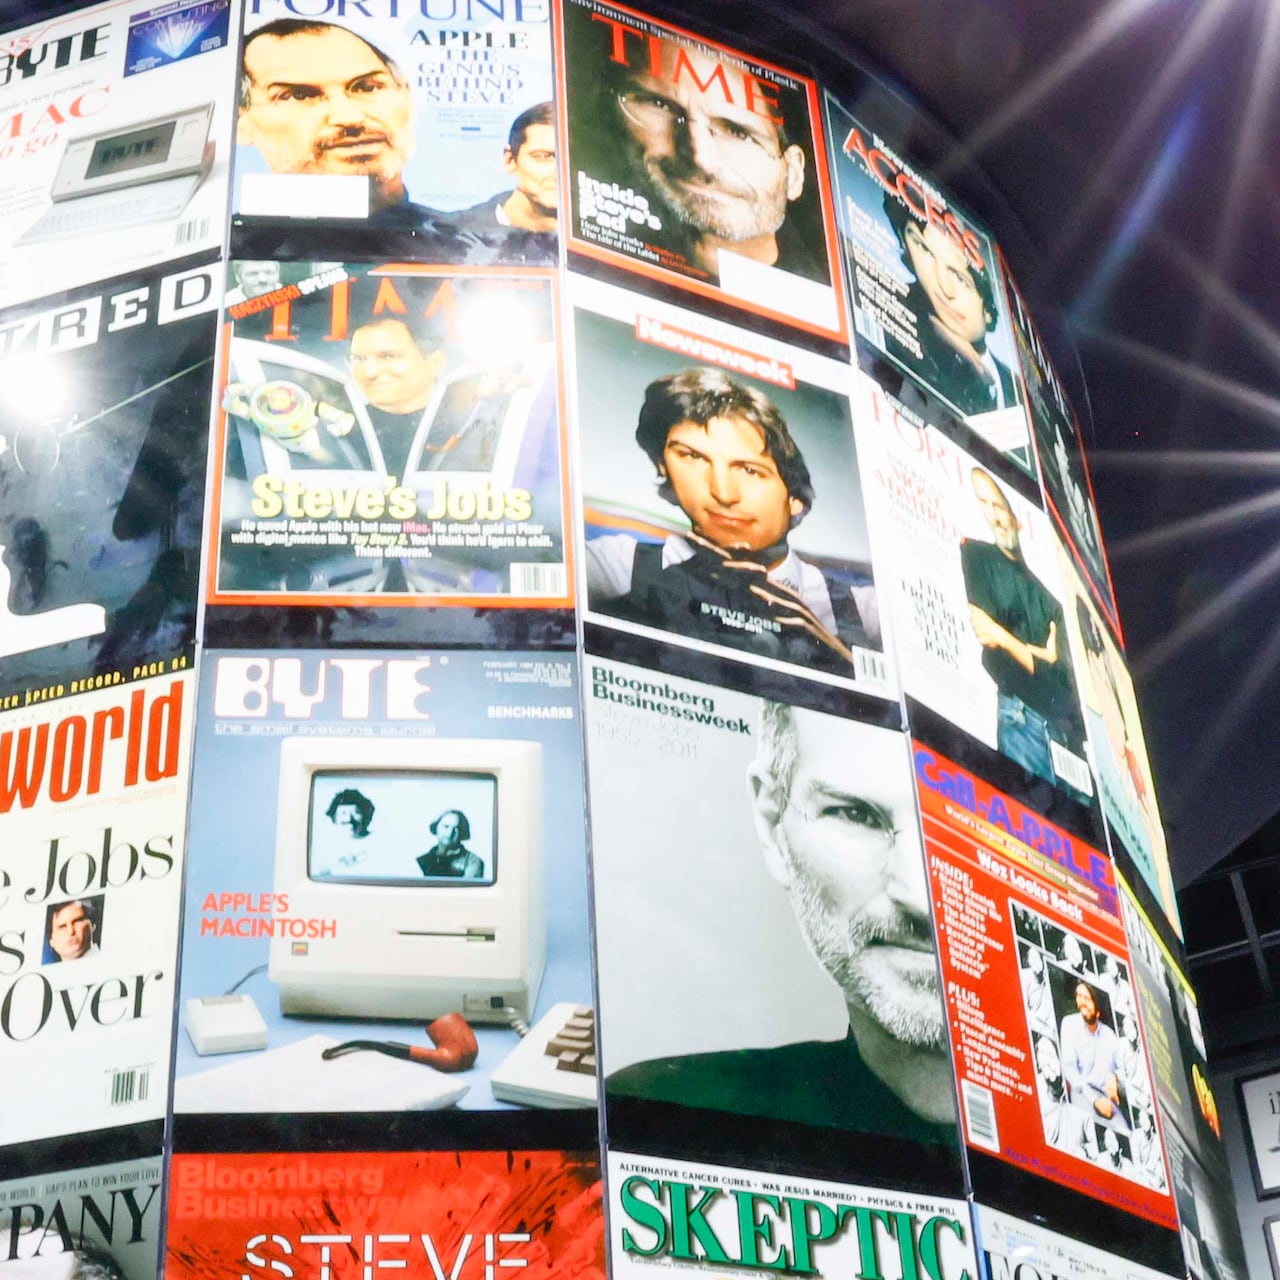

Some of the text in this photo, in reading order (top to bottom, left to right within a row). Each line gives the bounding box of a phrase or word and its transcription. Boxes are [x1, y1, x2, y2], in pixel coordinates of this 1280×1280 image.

[410, 29, 530, 49] APPLE
[417, 77, 524, 89] BEHIND
[418, 62, 521, 76] GENIUS
[591, 14, 785, 125] TIME
[426, 90, 515, 104] STEVE
[843, 127, 986, 272] ACCESS
[639, 316, 792, 384] Newsweek
[251, 474, 532, 521] Steve's Jobs
[24, 686, 65, 706] SPEED
[70, 671, 126, 693] RECORD,
[131, 662, 166, 681] PAGE
[214, 656, 432, 720] BYTE
[591, 666, 716, 712] Bloomberg
[487, 706, 573, 720] BENCHMARKS
[591, 681, 751, 736] Businessweek
[24, 827, 175, 904] Jobs
[977, 849, 1084, 922] Woz Looks Back
[202, 892, 290, 914] APPLE'S
[200, 918, 337, 939] MACINTOSH
[0, 970, 164, 1042] Over
